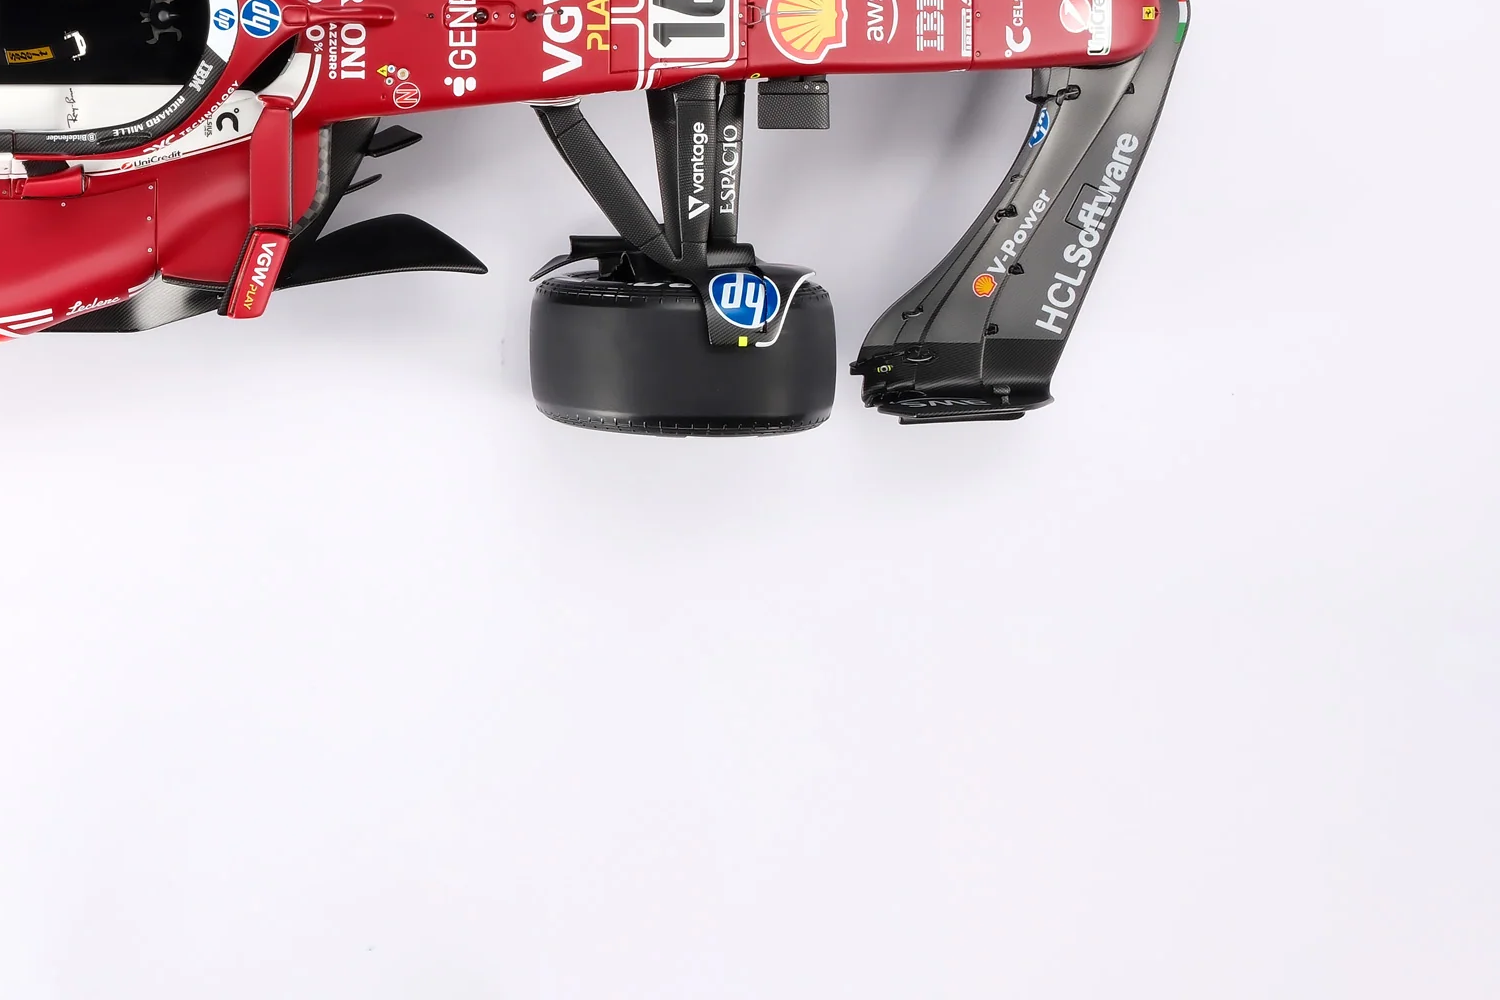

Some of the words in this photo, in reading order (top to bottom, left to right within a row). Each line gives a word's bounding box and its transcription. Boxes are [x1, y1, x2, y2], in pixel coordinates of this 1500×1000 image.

[213, 10, 235, 30] hp
[241, 0, 280, 33] hp
[328, 22, 338, 80] AZZURRO
[188, 60, 214, 92] IBM
[65, 87, 79, 129] Ray-Ban
[145, 95, 186, 128] RICHARD
[179, 80, 240, 136] TECHNOLOGY
[46, 133, 87, 143] Bitdefender
[112, 123, 145, 138] MILLE
[133, 150, 182, 169] UniCredit
[691, 121, 708, 194] vantage
[719, 124, 738, 215] ESPACIO
[987, 188, 1051, 274] V-Power
[1035, 132, 1139, 335] HCLSoftware
[251, 242, 277, 288] VGW
[66, 296, 121, 316] Leclerc
[243, 284, 258, 311] PLAY
[720, 273, 767, 328] hp
